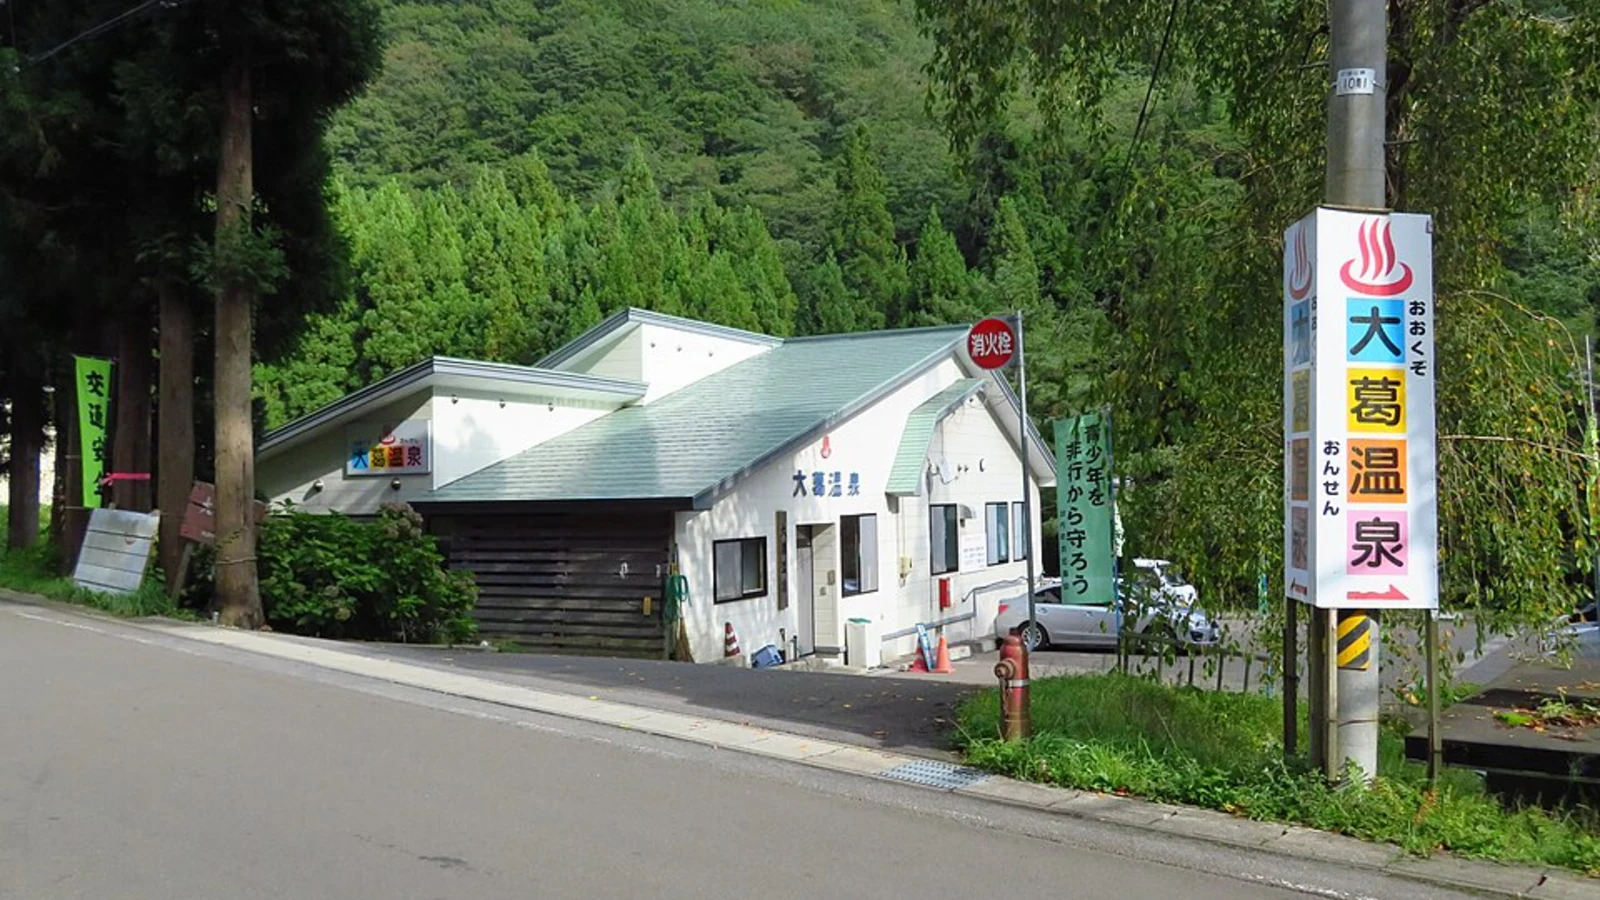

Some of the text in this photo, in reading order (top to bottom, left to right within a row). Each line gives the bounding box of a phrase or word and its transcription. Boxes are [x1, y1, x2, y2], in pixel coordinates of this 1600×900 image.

[971, 331, 1012, 357] 消火栓
[1409, 300, 1427, 376] おおくぞ
[1085, 424, 1105, 506] 青少年を
[1349, 306, 1404, 568] 大葛温泉
[792, 469, 860, 498] 大葛温泉
[1323, 440, 1340, 516] おんせん
[1066, 441, 1089, 595] 非行から守ろう
